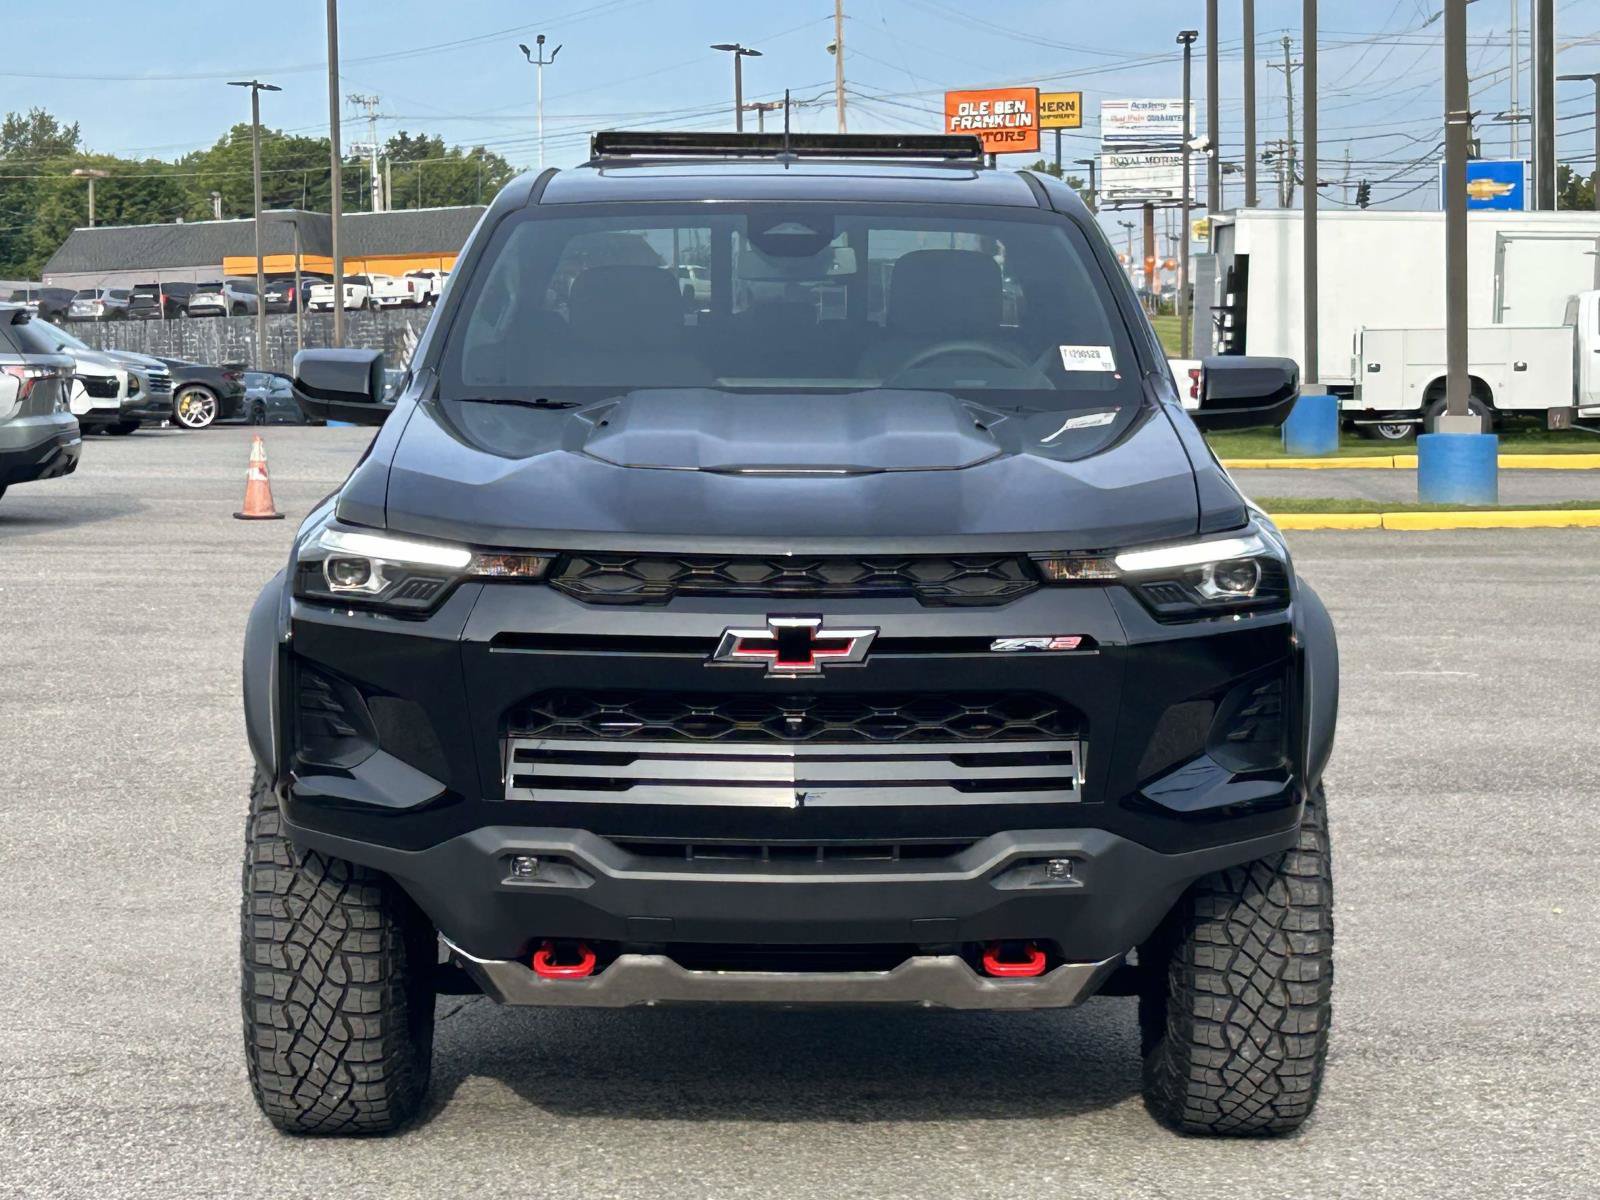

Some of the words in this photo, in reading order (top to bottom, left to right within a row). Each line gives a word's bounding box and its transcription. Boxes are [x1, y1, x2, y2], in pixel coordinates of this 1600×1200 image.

[958, 101, 990, 116] OLE
[994, 100, 1026, 115] BEN
[950, 113, 1032, 131] FRANKLIN
[978, 131, 1026, 143] TORS
[990, 636, 1082, 651] ZR2
